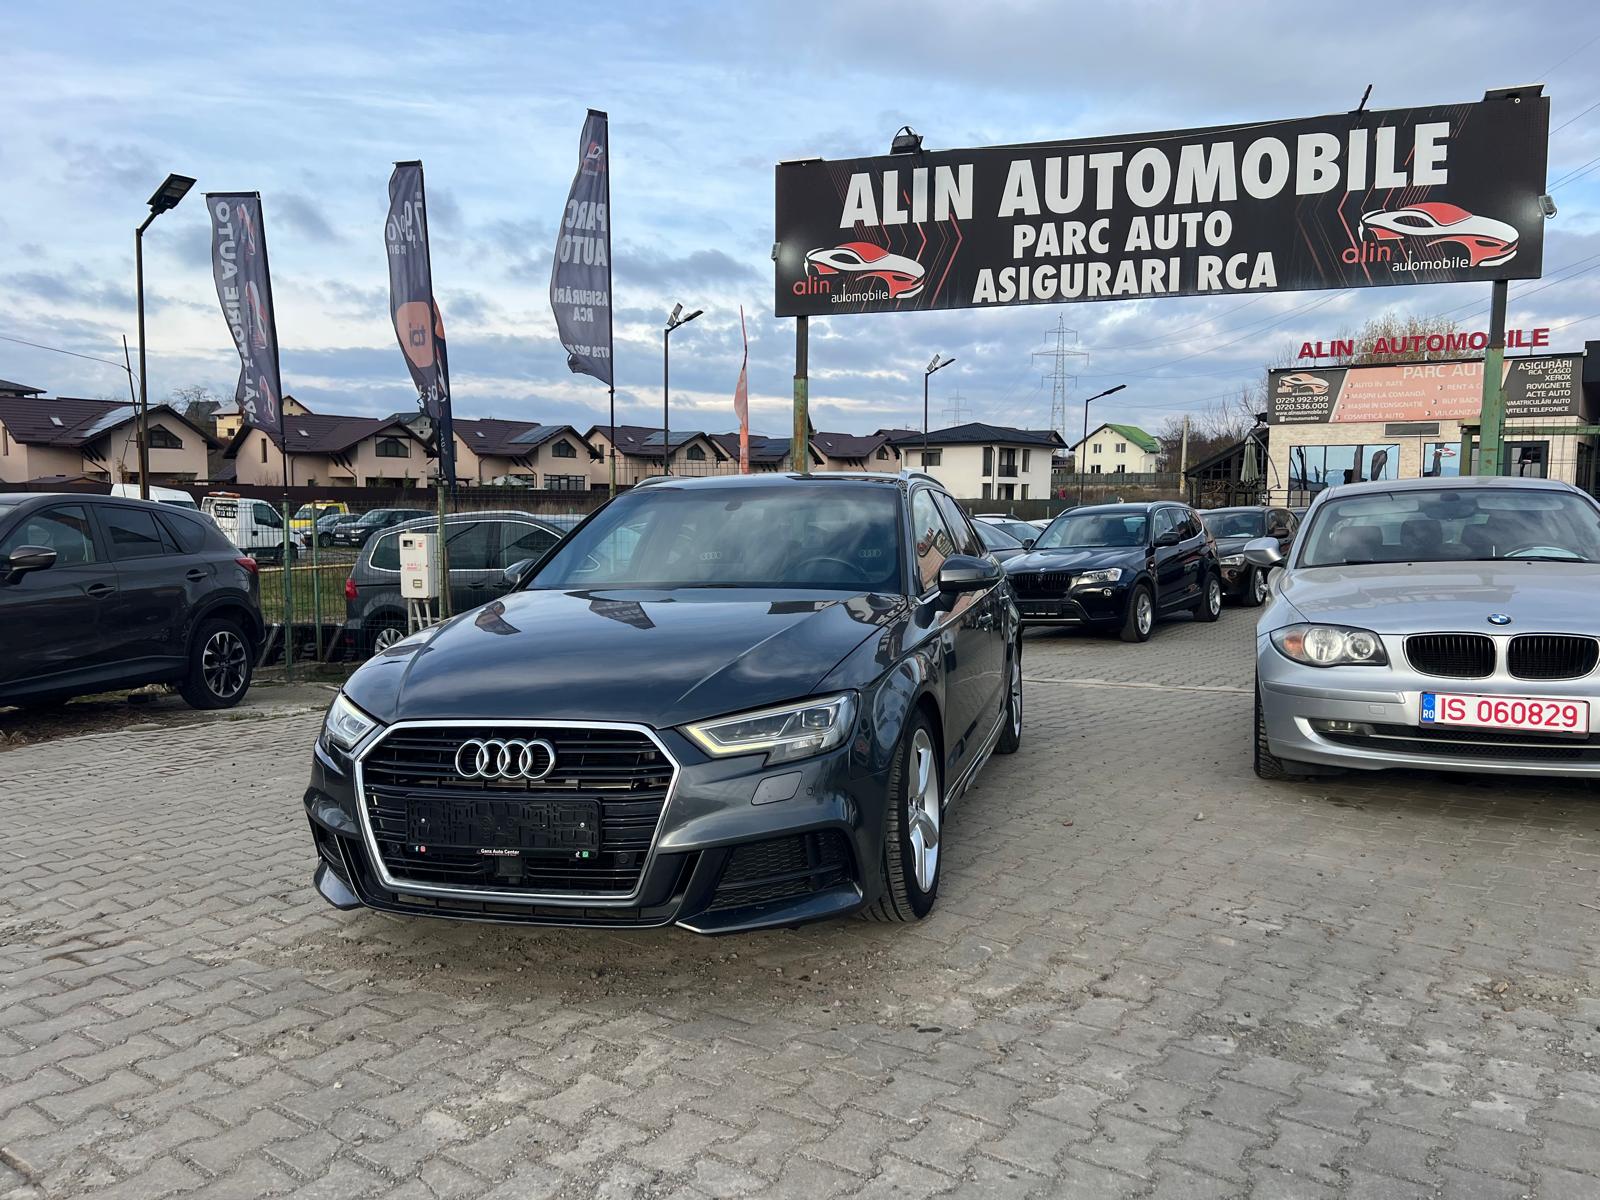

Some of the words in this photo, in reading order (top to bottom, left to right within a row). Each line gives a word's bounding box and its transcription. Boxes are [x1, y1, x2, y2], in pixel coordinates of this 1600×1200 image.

[839, 163, 974, 229] ALIN
[998, 121, 1450, 218] AUTOMOBILE
[1013, 218, 1110, 259] PARC
[1124, 209, 1233, 252] AUTO
[1341, 240, 1391, 264] alin
[792, 274, 830, 296] alin
[972, 256, 1180, 304] ASIGURARI
[1197, 251, 1278, 291] RCA
[1298, 339, 1354, 359] ALIN
[1372, 328, 1550, 356] AUTOMOILE
[1403, 365, 1447, 379] PARC
[1518, 358, 1573, 370] ASIGURĂRI
[1526, 381, 1571, 390] ROVIGNETE
[1548, 389, 1571, 397] AUTO
[1275, 396, 1329, 404] 0729.992.999
[1275, 403, 1329, 411] 0720.536.000
[1422, 709, 1434, 719] RO
[1440, 697, 1466, 721] IS
[1477, 700, 1578, 728] 060829
